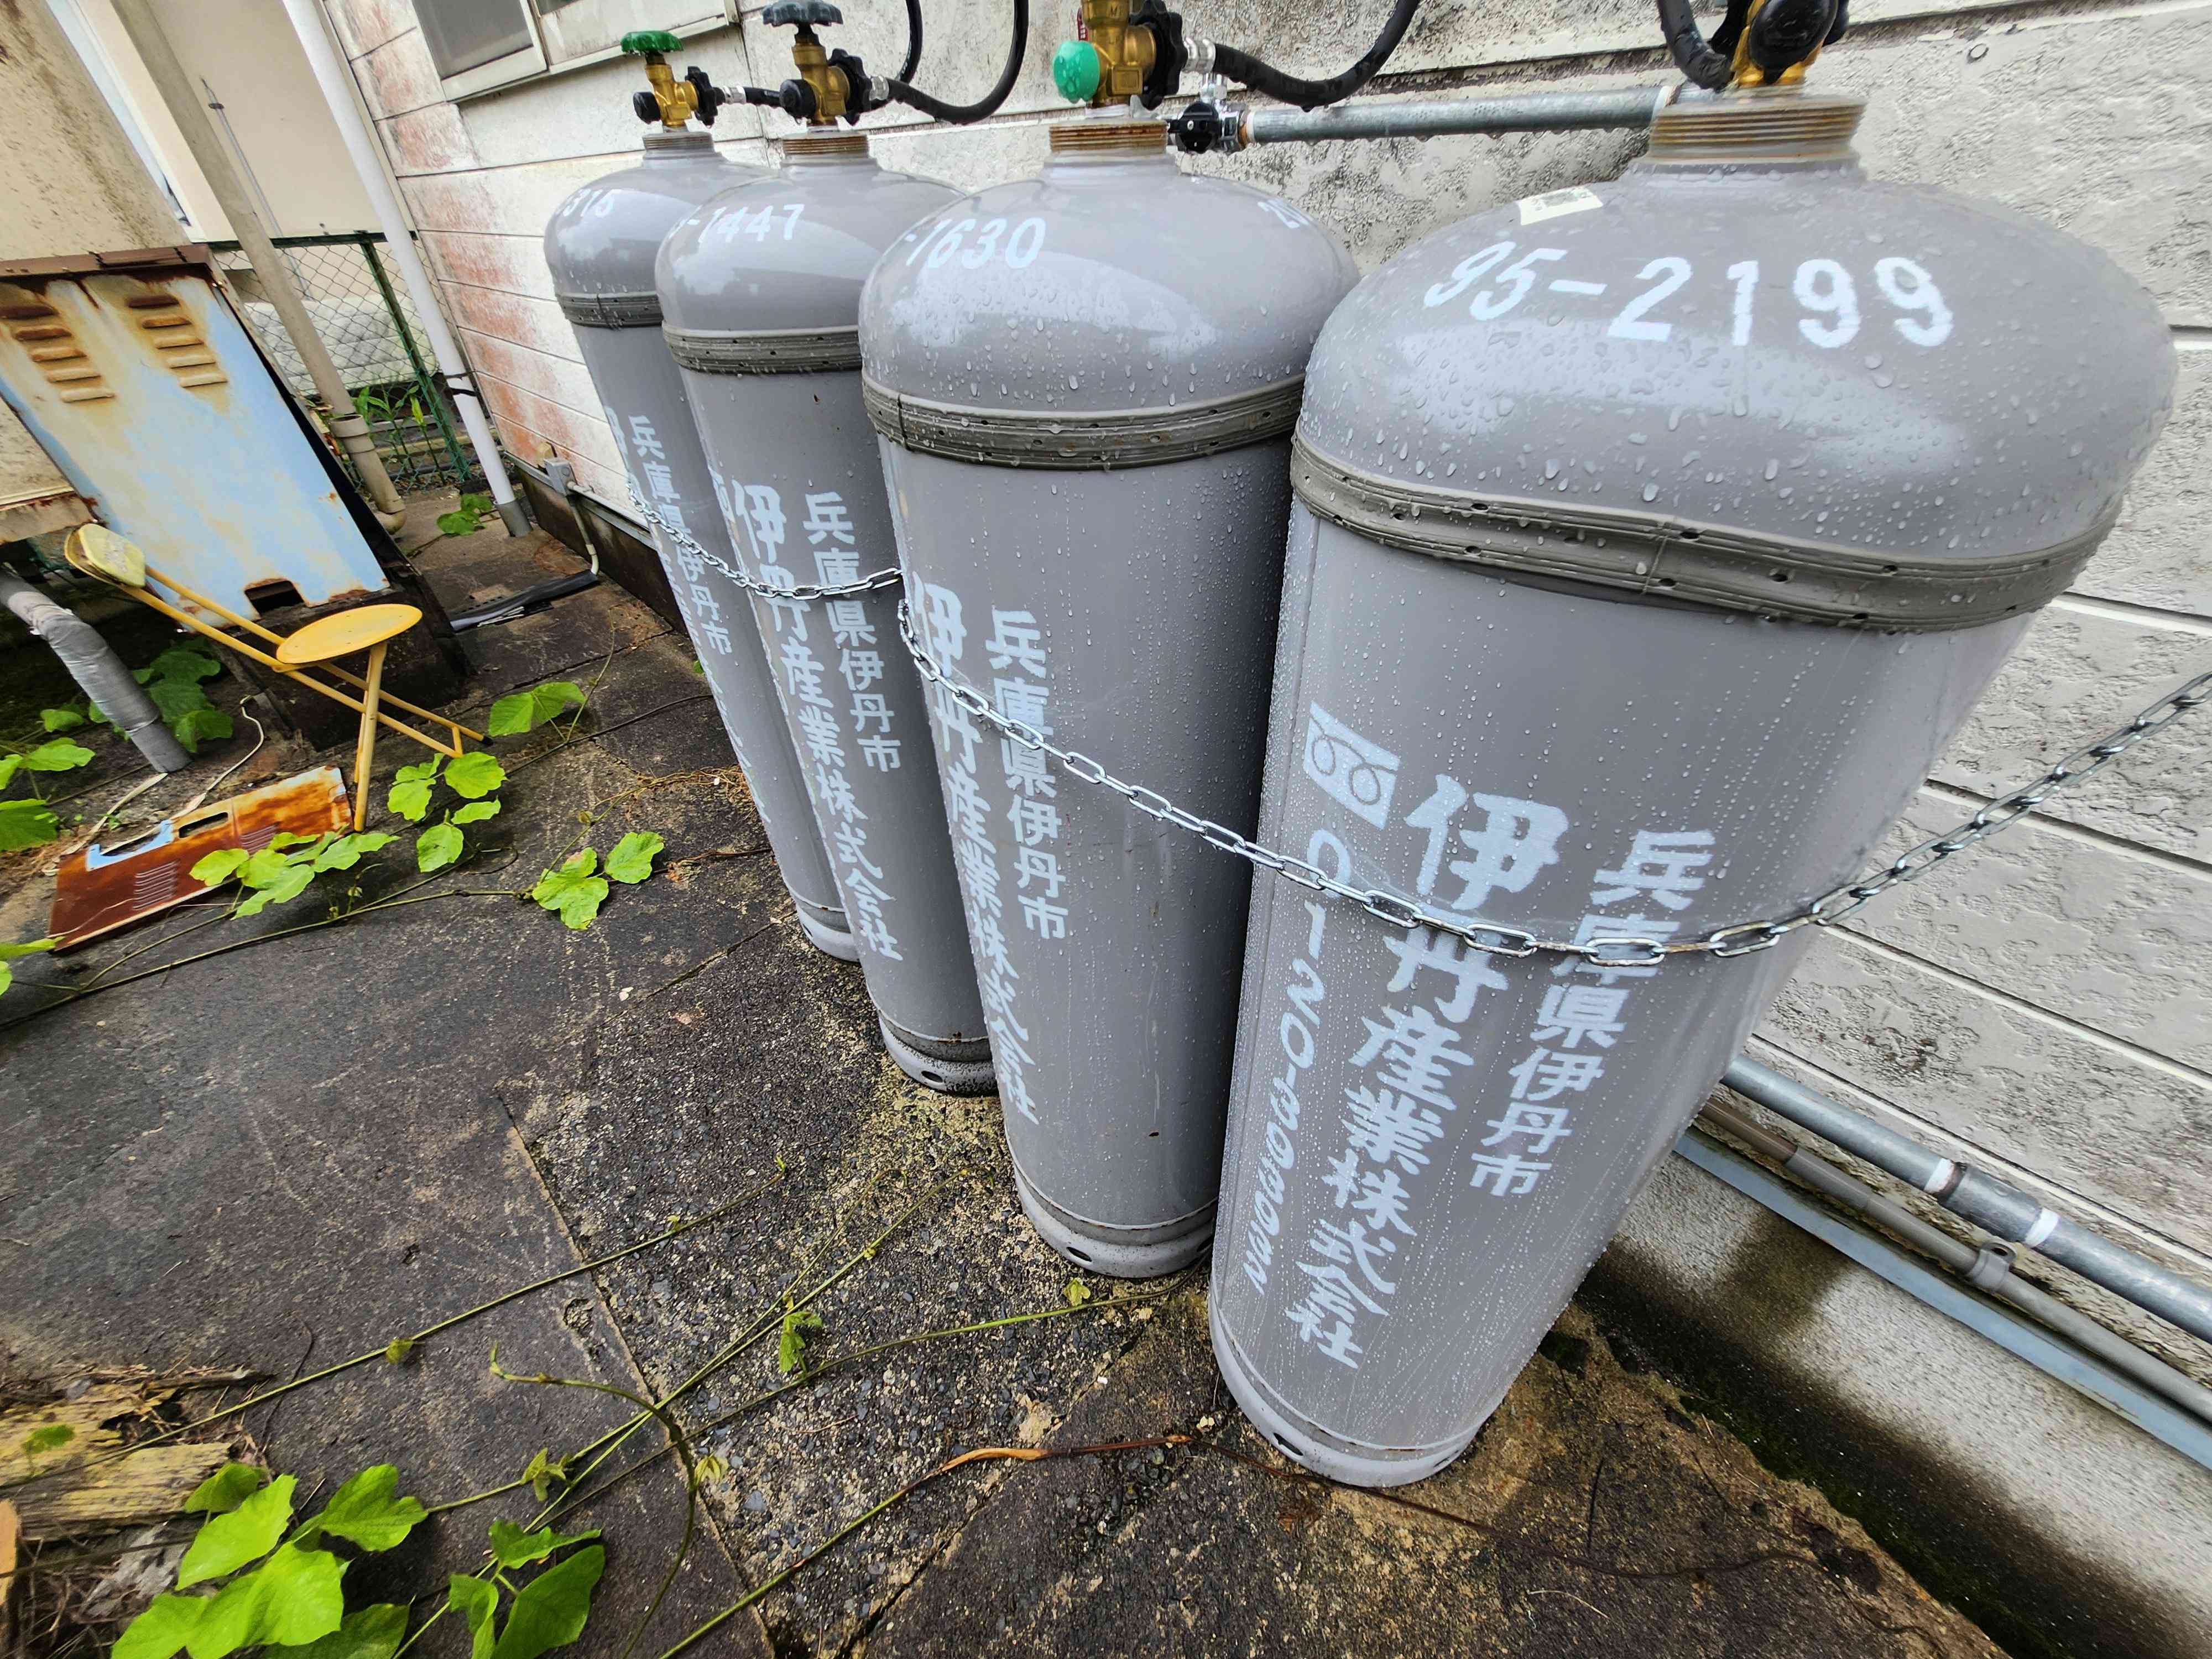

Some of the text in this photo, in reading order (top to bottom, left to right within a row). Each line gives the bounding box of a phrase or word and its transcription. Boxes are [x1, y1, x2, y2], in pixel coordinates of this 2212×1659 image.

[669, 204, 805, 243] -1447
[1424, 241, 1954, 349] 95-2199
[803, 491, 901, 772] 兵庫県伊丹市
[986, 608, 1069, 939] 兵庫県伊丹市
[1284, 774, 1570, 1369] 伊丹産業株式会社
